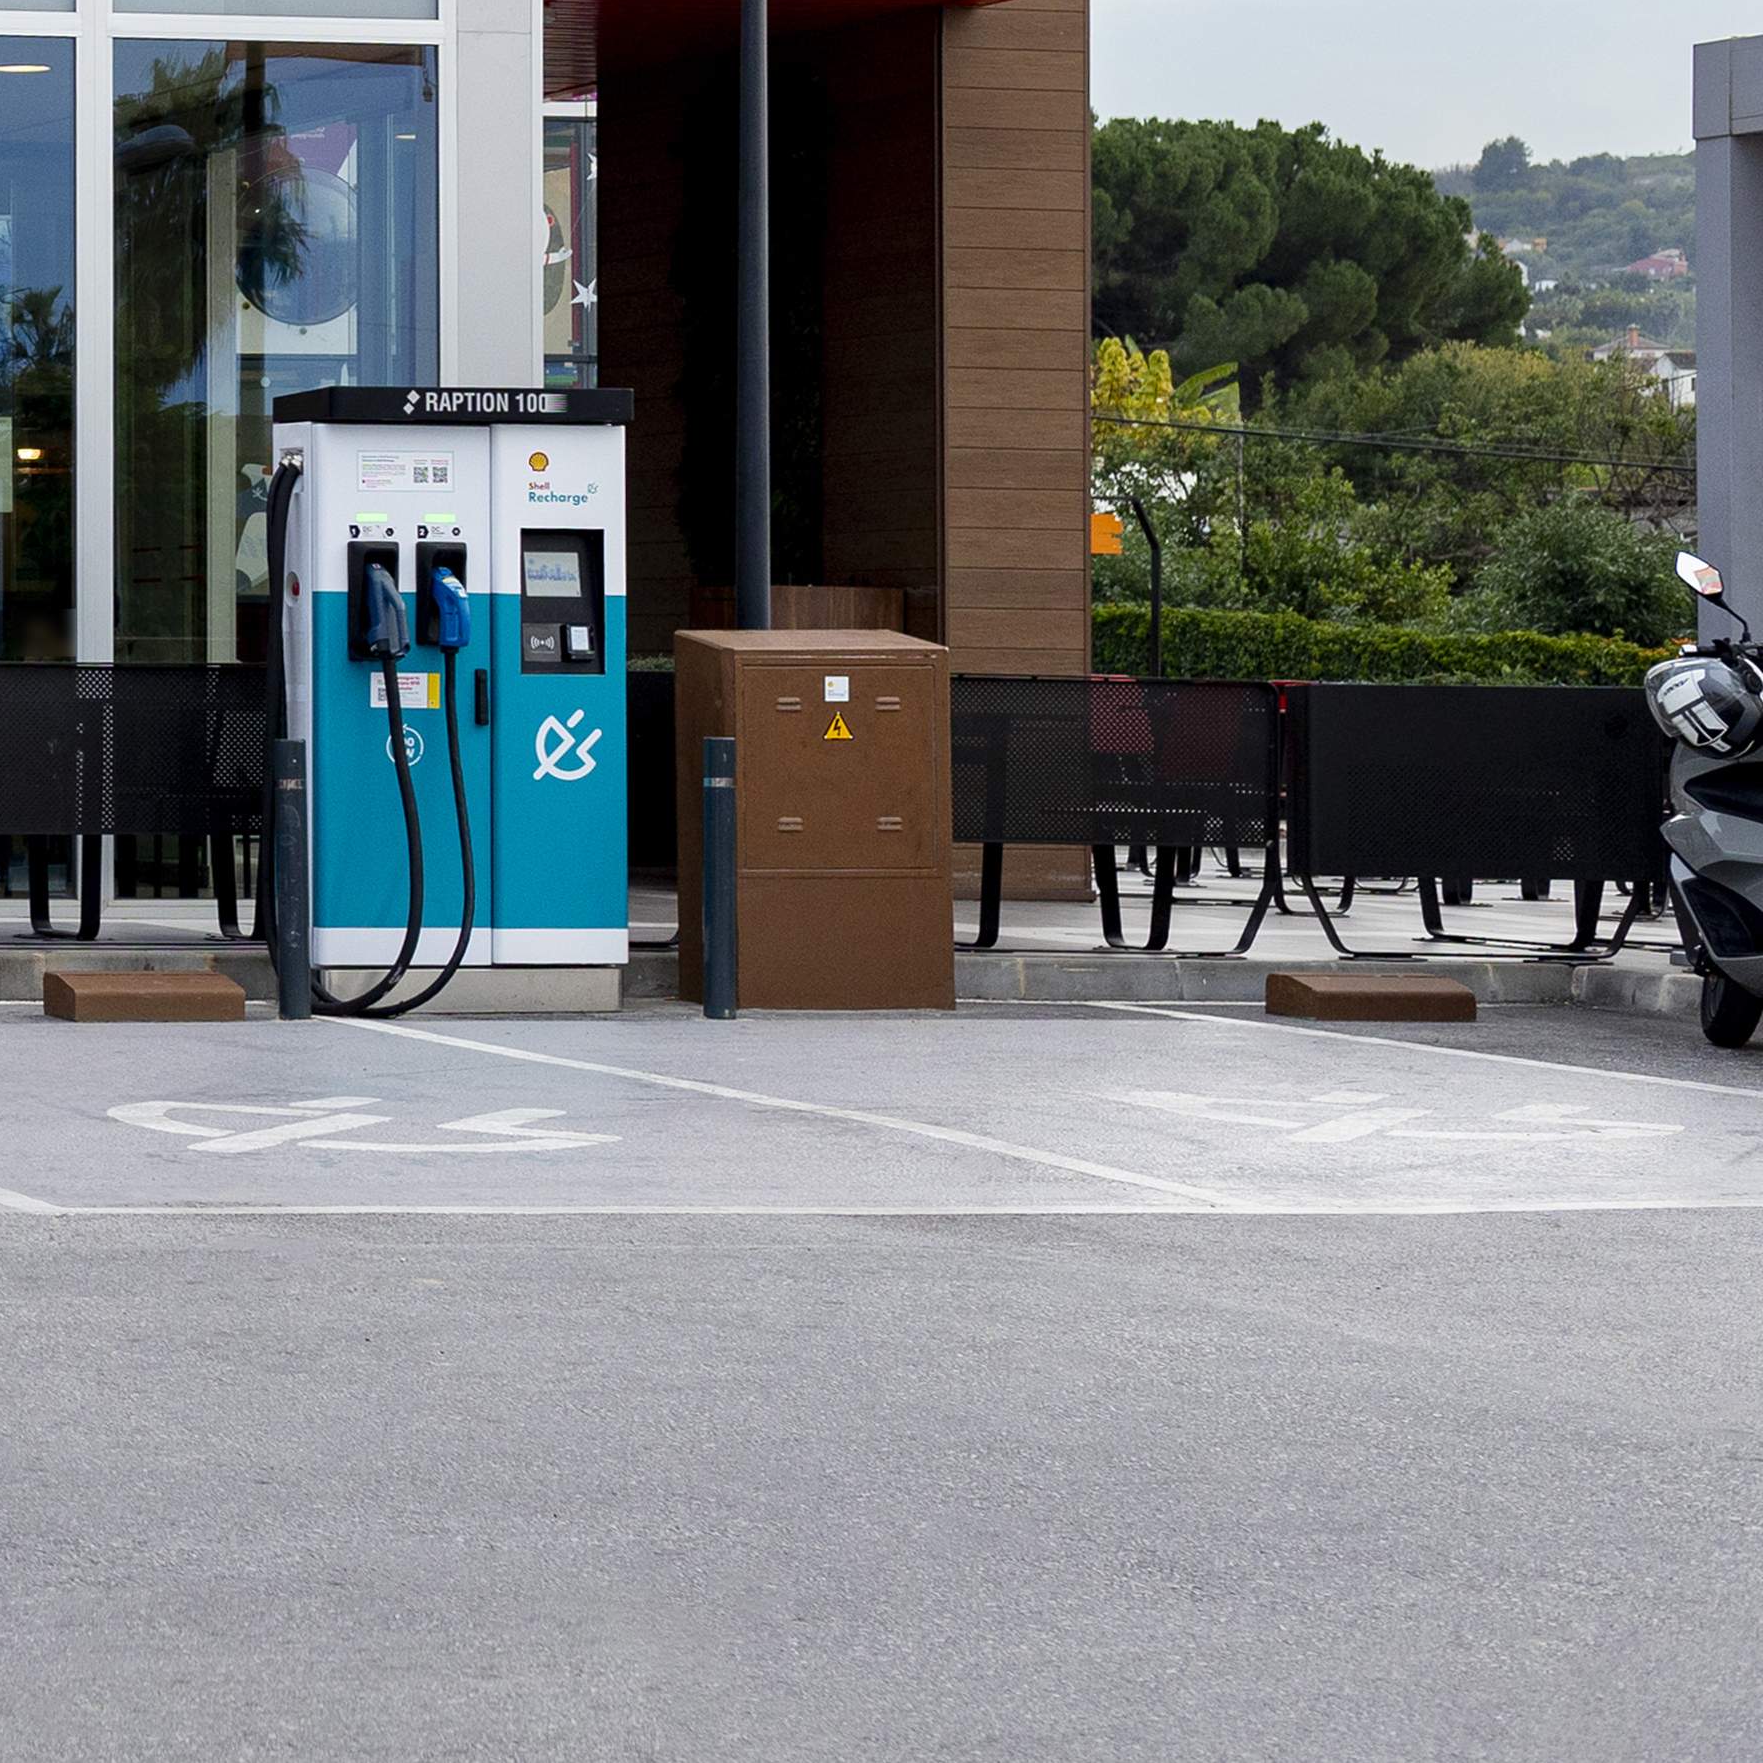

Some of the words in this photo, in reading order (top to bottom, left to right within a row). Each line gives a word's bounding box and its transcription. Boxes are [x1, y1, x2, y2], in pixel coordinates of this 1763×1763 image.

[426, 392, 509, 412] RAPTION
[515, 393, 551, 413] 100
[529, 482, 550, 490] Shell
[529, 491, 588, 505] Recharge
